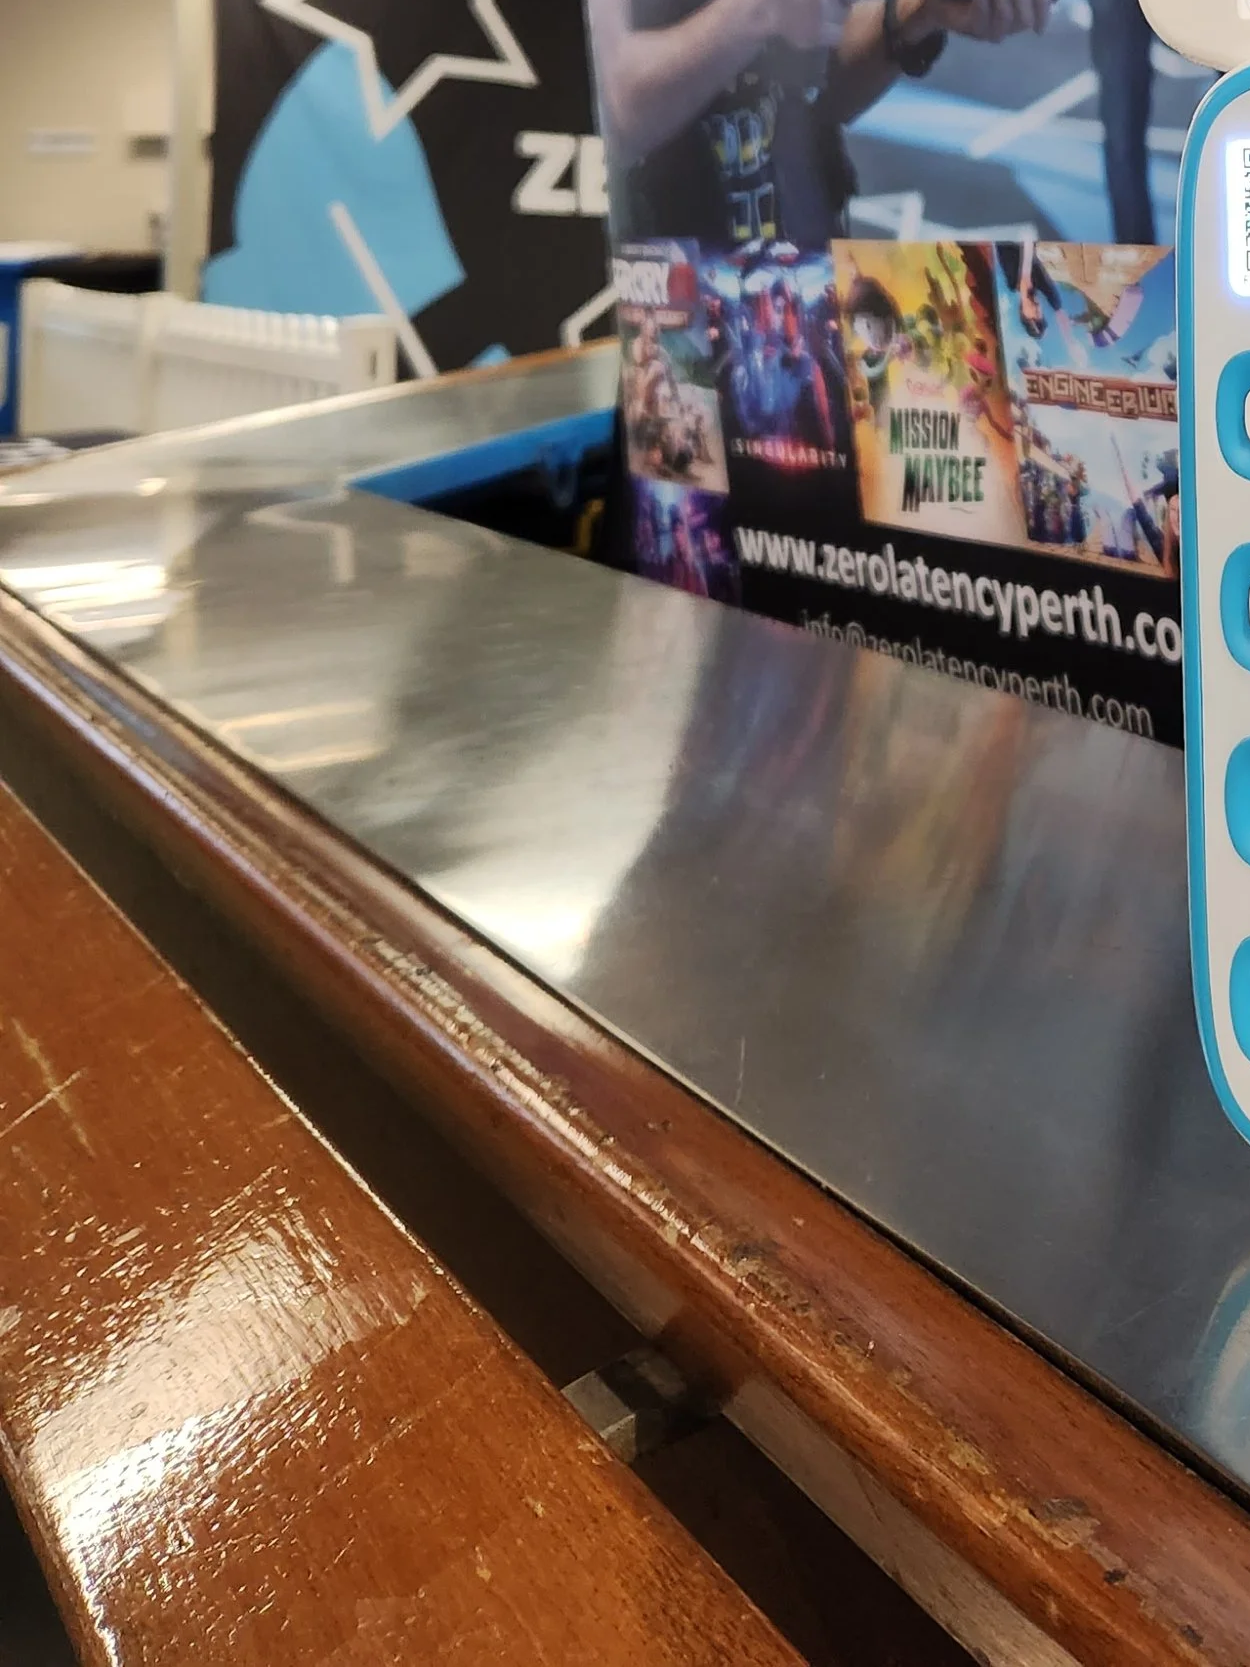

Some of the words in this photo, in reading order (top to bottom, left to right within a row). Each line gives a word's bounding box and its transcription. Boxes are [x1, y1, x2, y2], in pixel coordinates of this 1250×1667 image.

[889, 406, 962, 455] MISSION
[901, 453, 987, 514] MAYBEE
[735, 525, 1182, 663] www.zerolatencyperth.co
